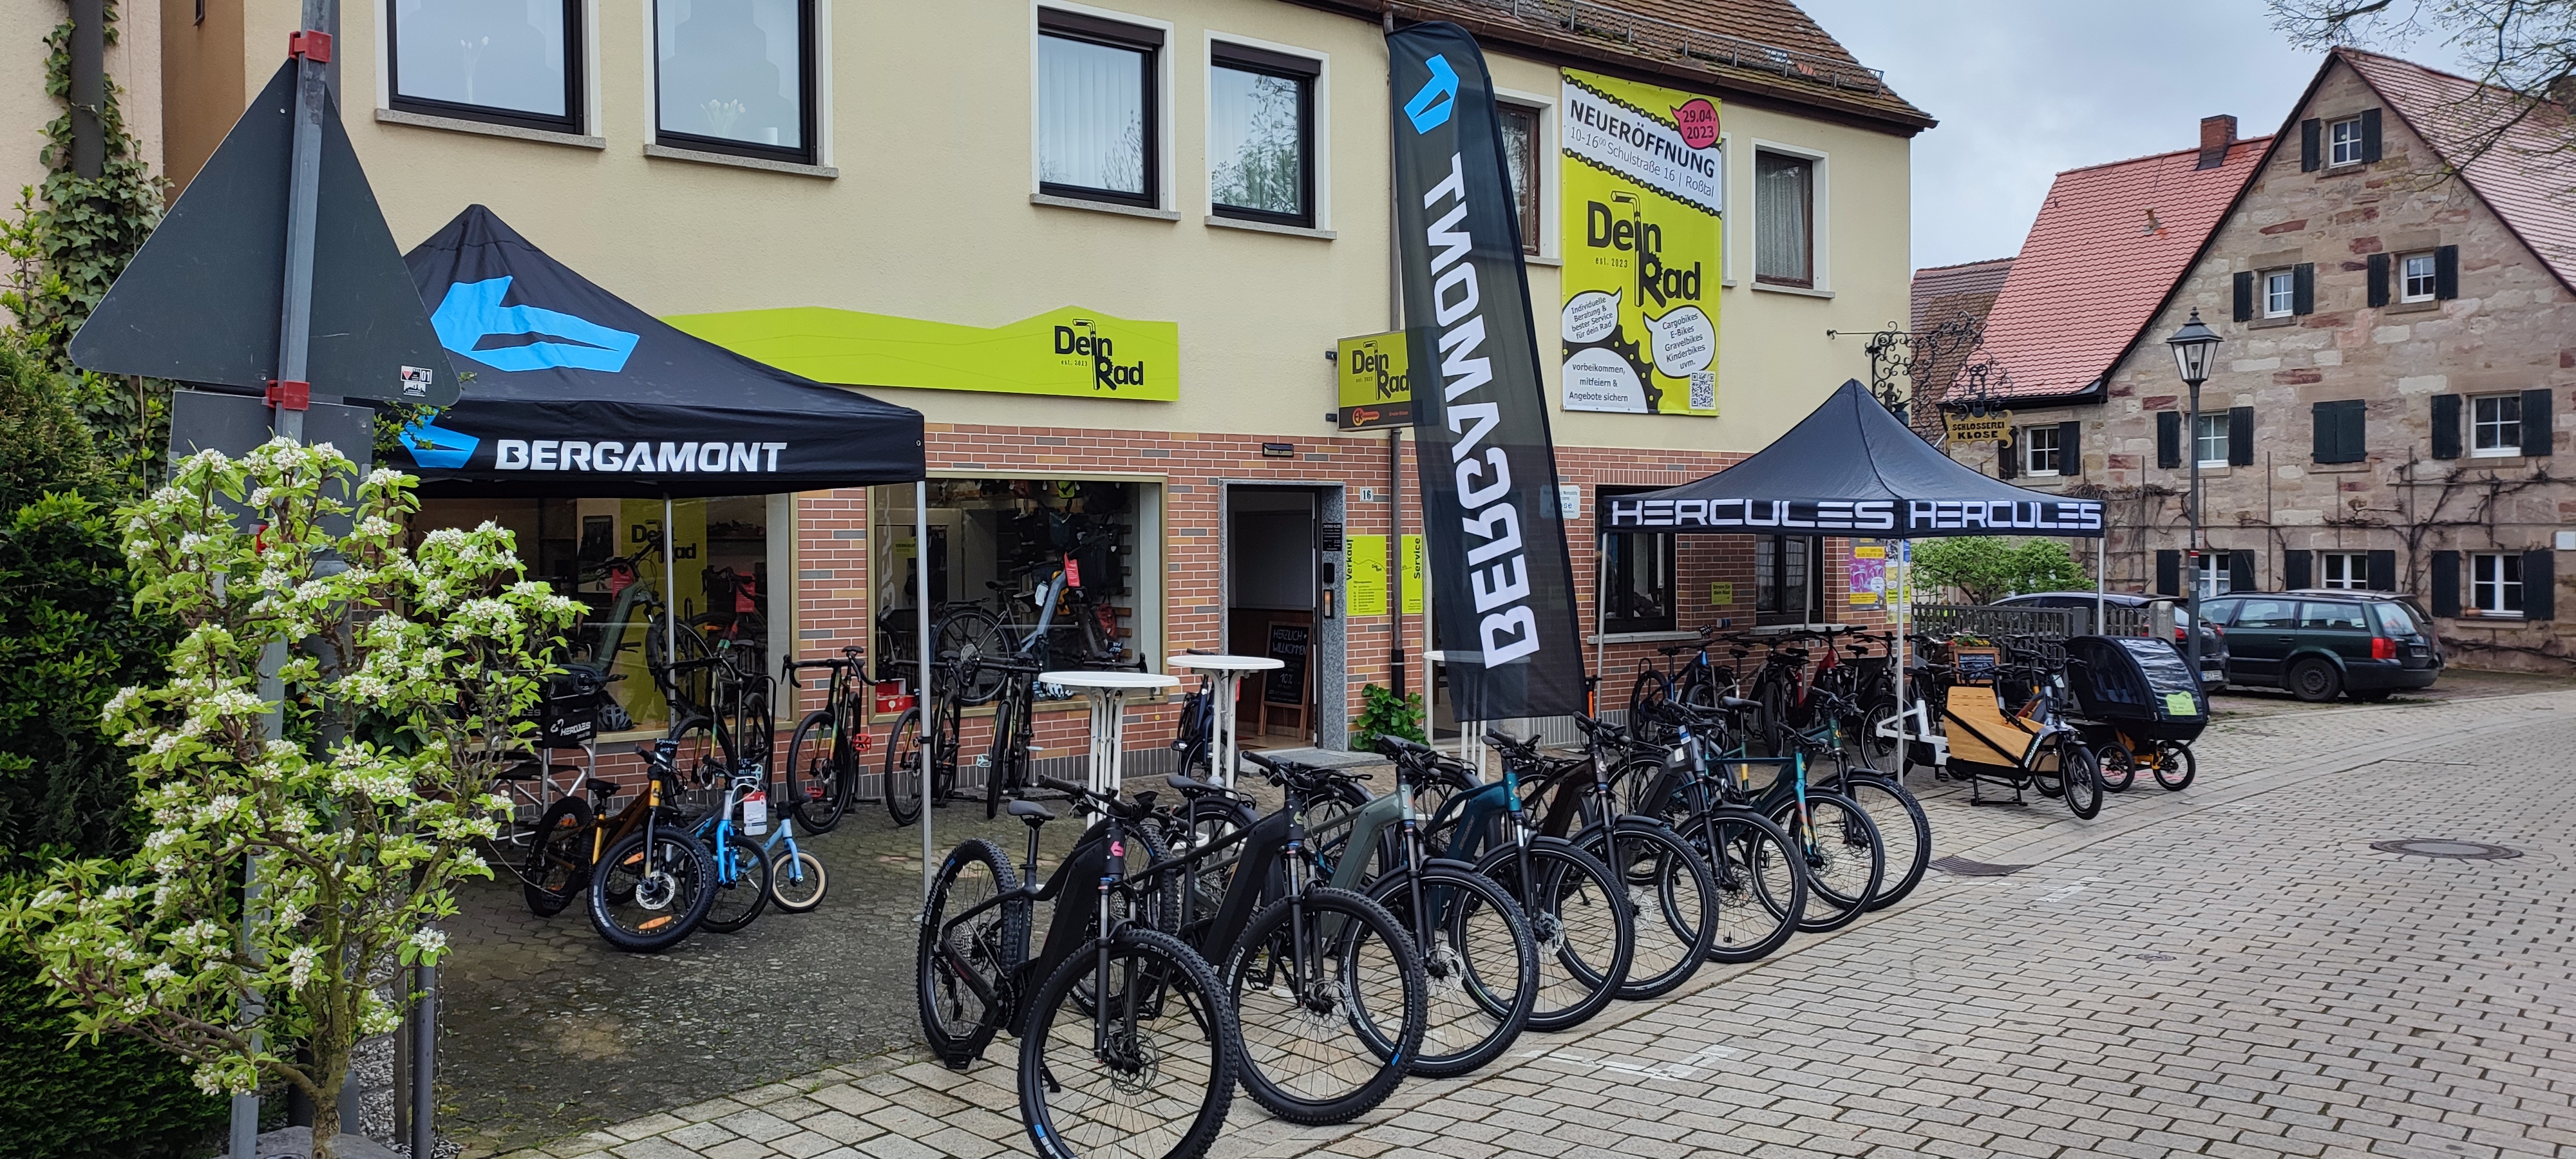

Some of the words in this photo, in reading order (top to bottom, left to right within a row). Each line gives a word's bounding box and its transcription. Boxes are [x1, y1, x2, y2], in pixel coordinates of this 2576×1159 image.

[1683, 109, 1716, 123] 29.04.
[1570, 99, 1715, 178] NEUERÖFFNUNG
[1687, 126, 1714, 140] 2023
[1607, 142, 1661, 176] Schulstraße
[1663, 167, 1676, 182] 16
[1685, 176, 1714, 198] Roßtal
[1587, 191, 1662, 253] Dein
[1595, 257, 1609, 265] est.
[1611, 258, 1628, 268] 2023
[1634, 250, 1701, 308] Rad
[1571, 296, 1607, 314] Individuelle
[1571, 321, 1590, 332] bester
[1591, 312, 1613, 325] Service
[1574, 308, 1601, 322] Beratung
[1662, 313, 1698, 330] Cargobikes
[1054, 319, 1113, 356] Dein
[1576, 331, 1586, 339] für
[1586, 326, 1599, 336] dein
[1600, 321, 1612, 332] Rad
[1670, 325, 1694, 339] E-Bikes
[1665, 334, 1703, 352] Gravelbikes
[1352, 341, 1388, 374] Dein
[1666, 344, 1705, 363] Kinderbikes
[1093, 355, 1144, 391] Rad
[1572, 363, 1625, 375] vorbeikommen,
[1680, 360, 1696, 370] uvm.
[1580, 378, 1611, 387] mitfeiern
[1569, 391, 1602, 401] Angebote
[1604, 393, 1628, 402] sichern
[1424, 152, 1540, 670] BERGAMONT
[1953, 421, 2005, 431] SCHLOSSEREI
[1958, 431, 1998, 440] KLOSE
[495, 440, 787, 472] BERGAMONT
[1363, 490, 1371, 500] 16
[1611, 499, 1893, 529] HERCULES
[1909, 500, 2101, 529] HERCULES
[1273, 628, 1302, 641] HERZLICH
[1273, 641, 1307, 655] WILLKOMMEN
[1280, 673, 1293, 684] 10%
[560, 721, 591, 736] HERCULES
[2024, 734, 2044, 768] BERGAMONT
[1226, 946, 1246, 994] NOBBY
